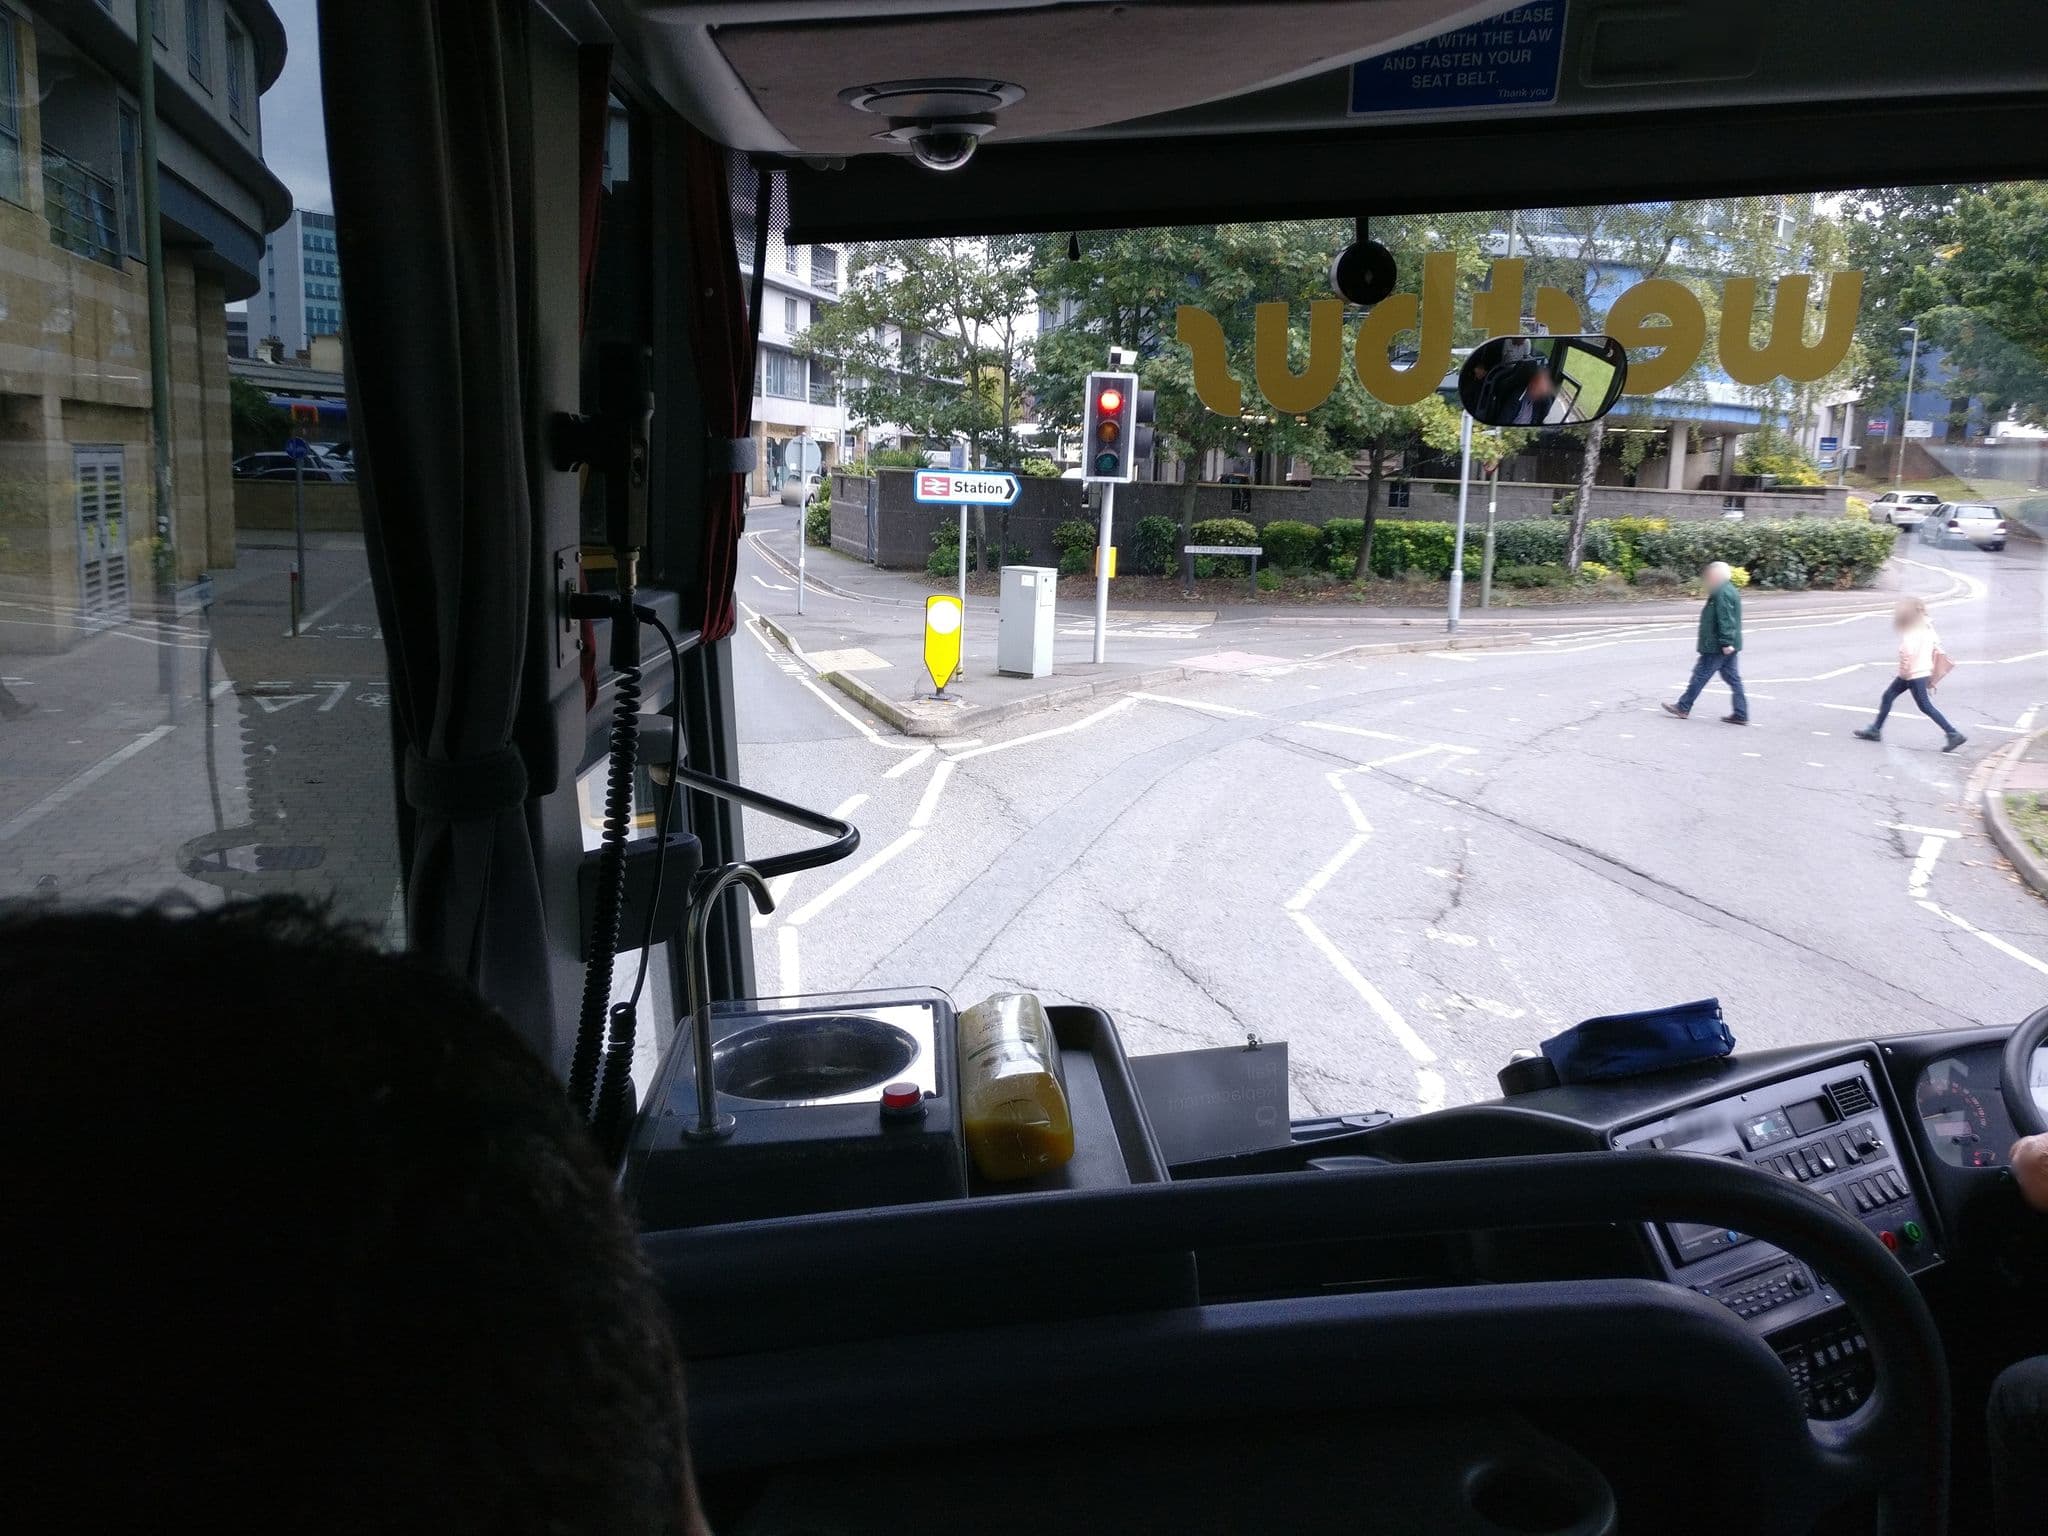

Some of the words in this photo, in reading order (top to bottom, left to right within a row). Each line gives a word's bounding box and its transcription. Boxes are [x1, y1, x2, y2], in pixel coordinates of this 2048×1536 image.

[1438, 33, 1477, 48] WITH
[1483, 31, 1512, 45] THE
[1519, 28, 1552, 43] LAW
[1383, 56, 1416, 71] AND
[1421, 52, 1482, 68] FASTEN
[1488, 49, 1532, 65] YOUR
[1412, 73, 1452, 88] SEAT
[1457, 70, 1500, 86] BELT.
[1499, 88, 1527, 97] Thank
[1530, 88, 1549, 98] you
[954, 481, 1003, 495] Station
